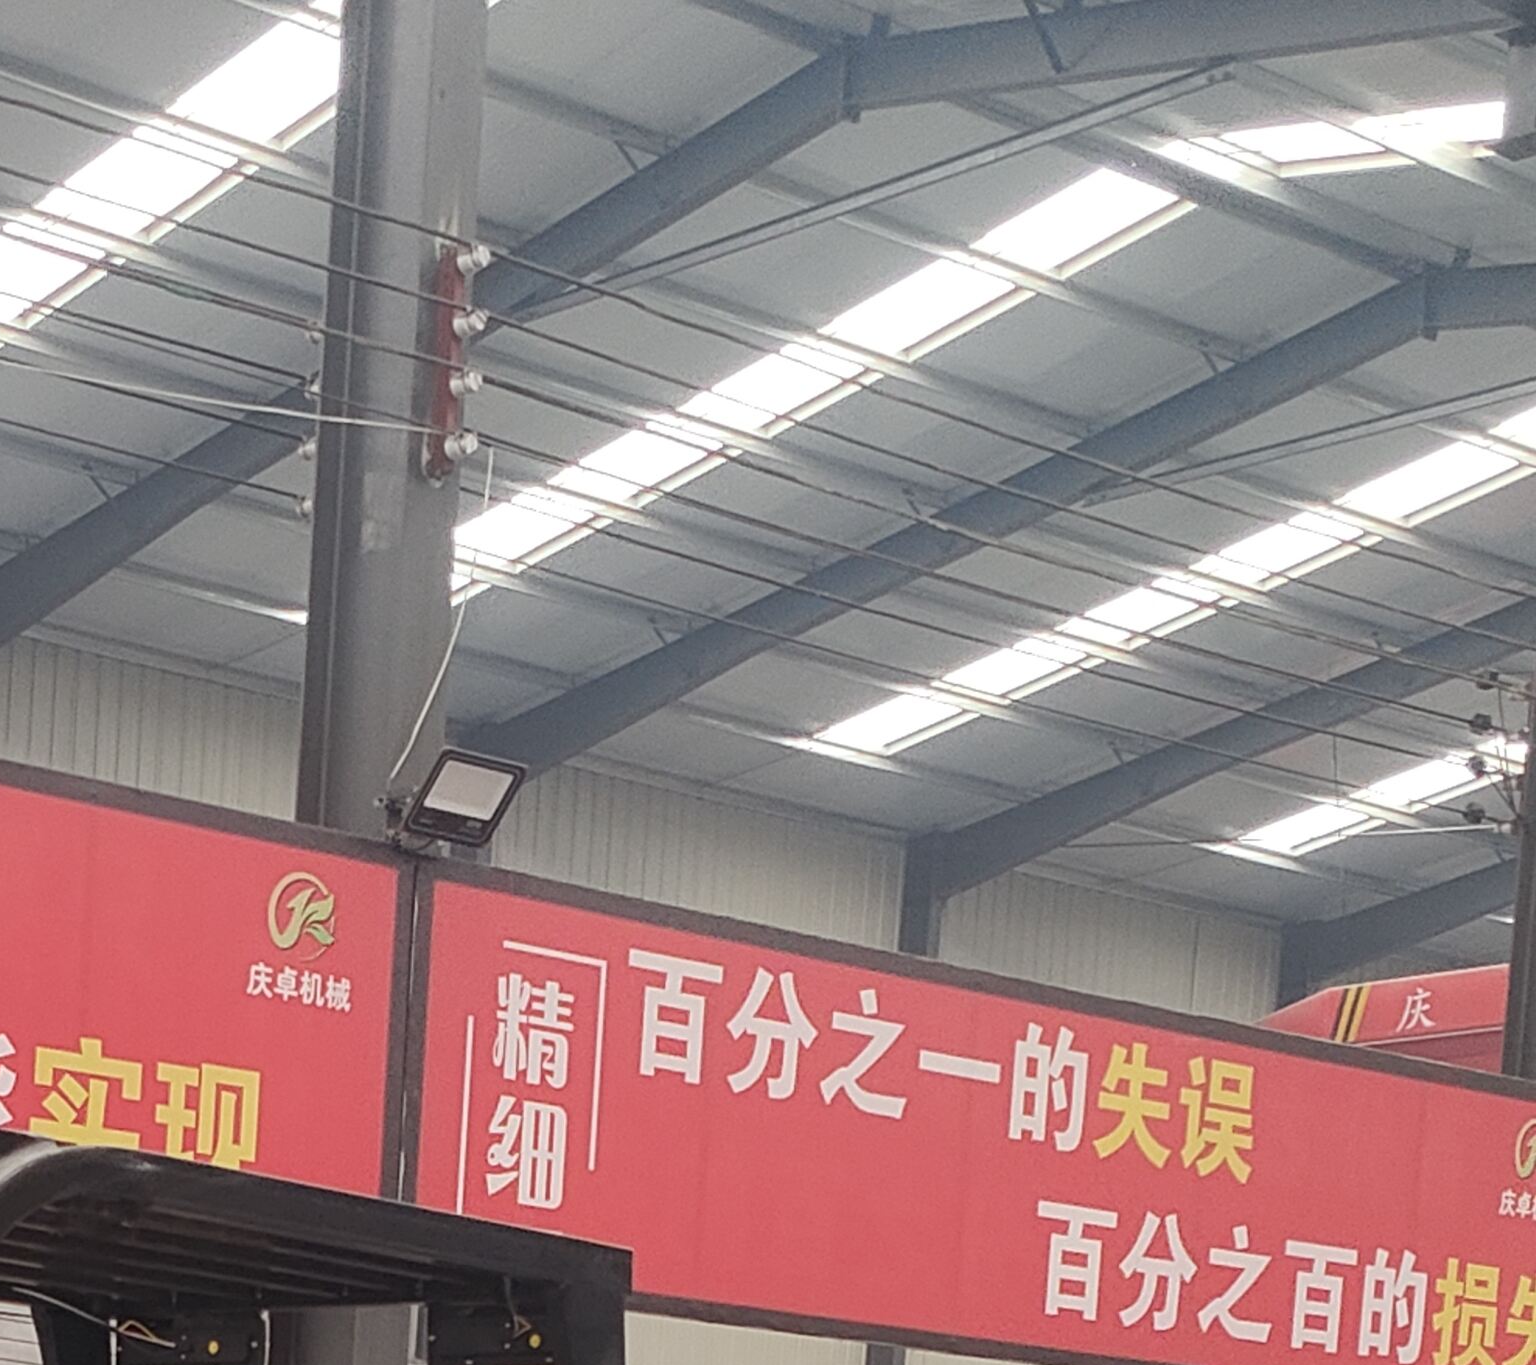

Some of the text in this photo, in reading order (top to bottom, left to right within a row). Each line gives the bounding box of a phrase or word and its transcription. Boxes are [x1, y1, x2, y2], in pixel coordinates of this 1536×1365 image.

[247, 962, 351, 1012] 庆卓机械
[485, 973, 574, 1209] 精细
[628, 948, 1255, 1183] 百分之一的失误
[1498, 1189, 1536, 1221] 庆卓
